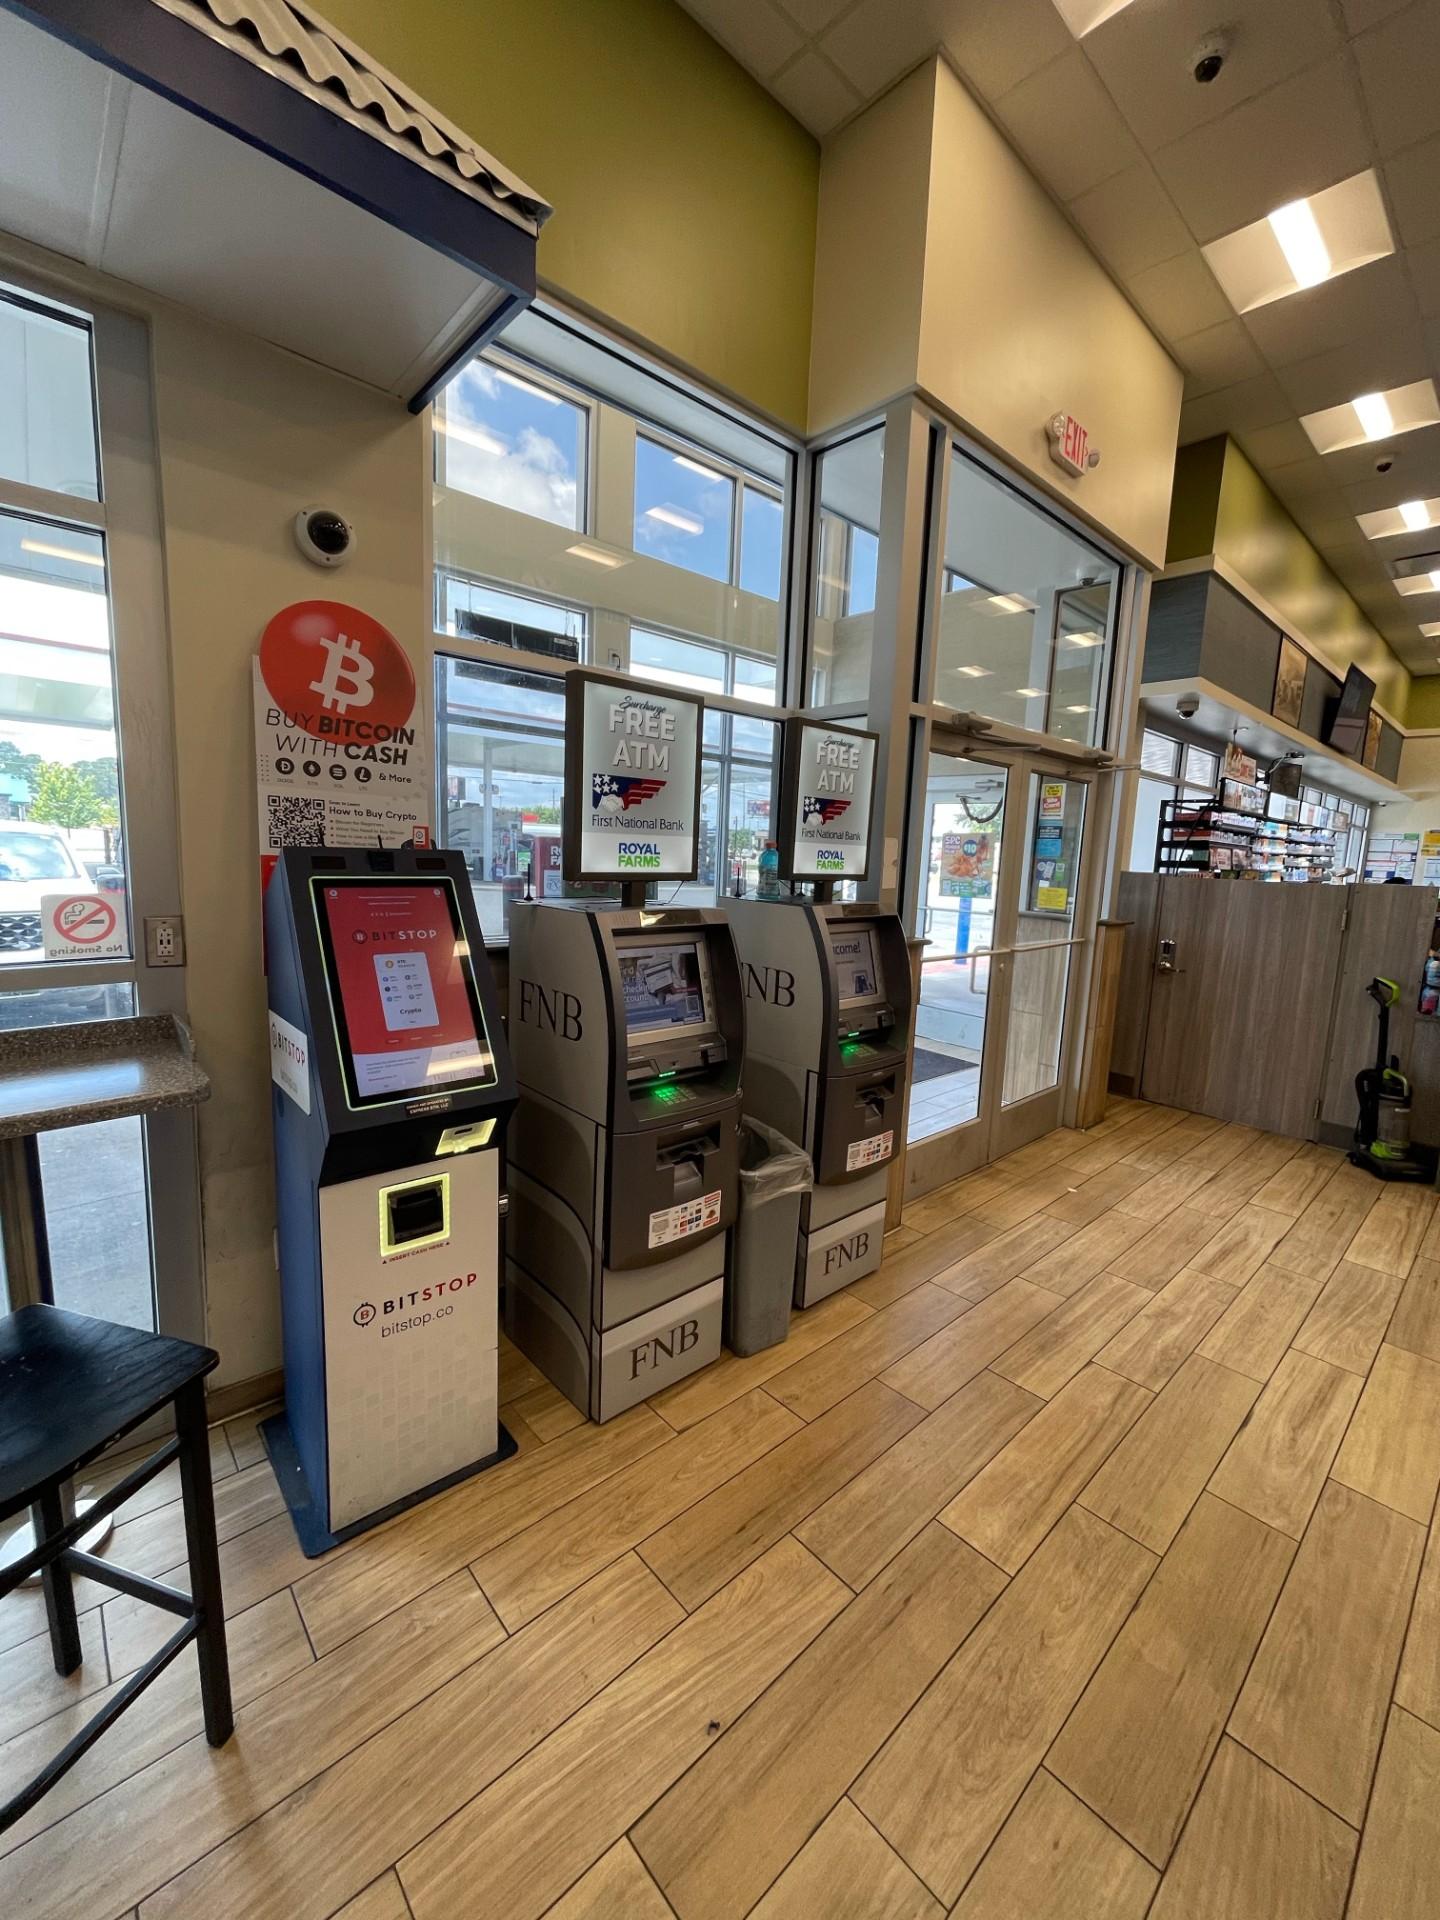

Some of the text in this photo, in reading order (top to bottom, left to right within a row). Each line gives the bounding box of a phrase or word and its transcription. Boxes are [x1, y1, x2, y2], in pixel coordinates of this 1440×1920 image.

[1064, 415, 1088, 469] EXIT
[618, 695, 667, 719] Surcharge
[266, 708, 415, 746] BUY BITCOIN
[608, 704, 677, 742] FREE
[275, 733, 408, 766] WITH CASH
[824, 735, 854, 750] Surcharge
[611, 739, 670, 773] ATM
[815, 743, 860, 770] FREE
[378, 772, 412, 784] & More
[816, 769, 854, 795] ATM
[329, 806, 418, 822] How to Buy Crypto
[591, 814, 684, 832] First National Bank
[801, 828, 861, 842] First National Bank
[618, 842, 661, 856] ROYAL
[618, 855, 661, 868] FARMS
[816, 850, 845, 861] ROYAL
[816, 860, 845, 871] FARMS
[372, 929, 437, 941] BITSTOP
[741, 961, 796, 1008] NB
[400, 1007, 422, 1016] Crypto
[519, 978, 583, 1042] FNB
[277, 1031, 306, 1067] BITSTOP
[823, 1231, 870, 1277] FNB
[383, 1272, 477, 1315] BITSTOP
[381, 1305, 454, 1338] bitstop.co
[629, 1318, 700, 1382] FNB
